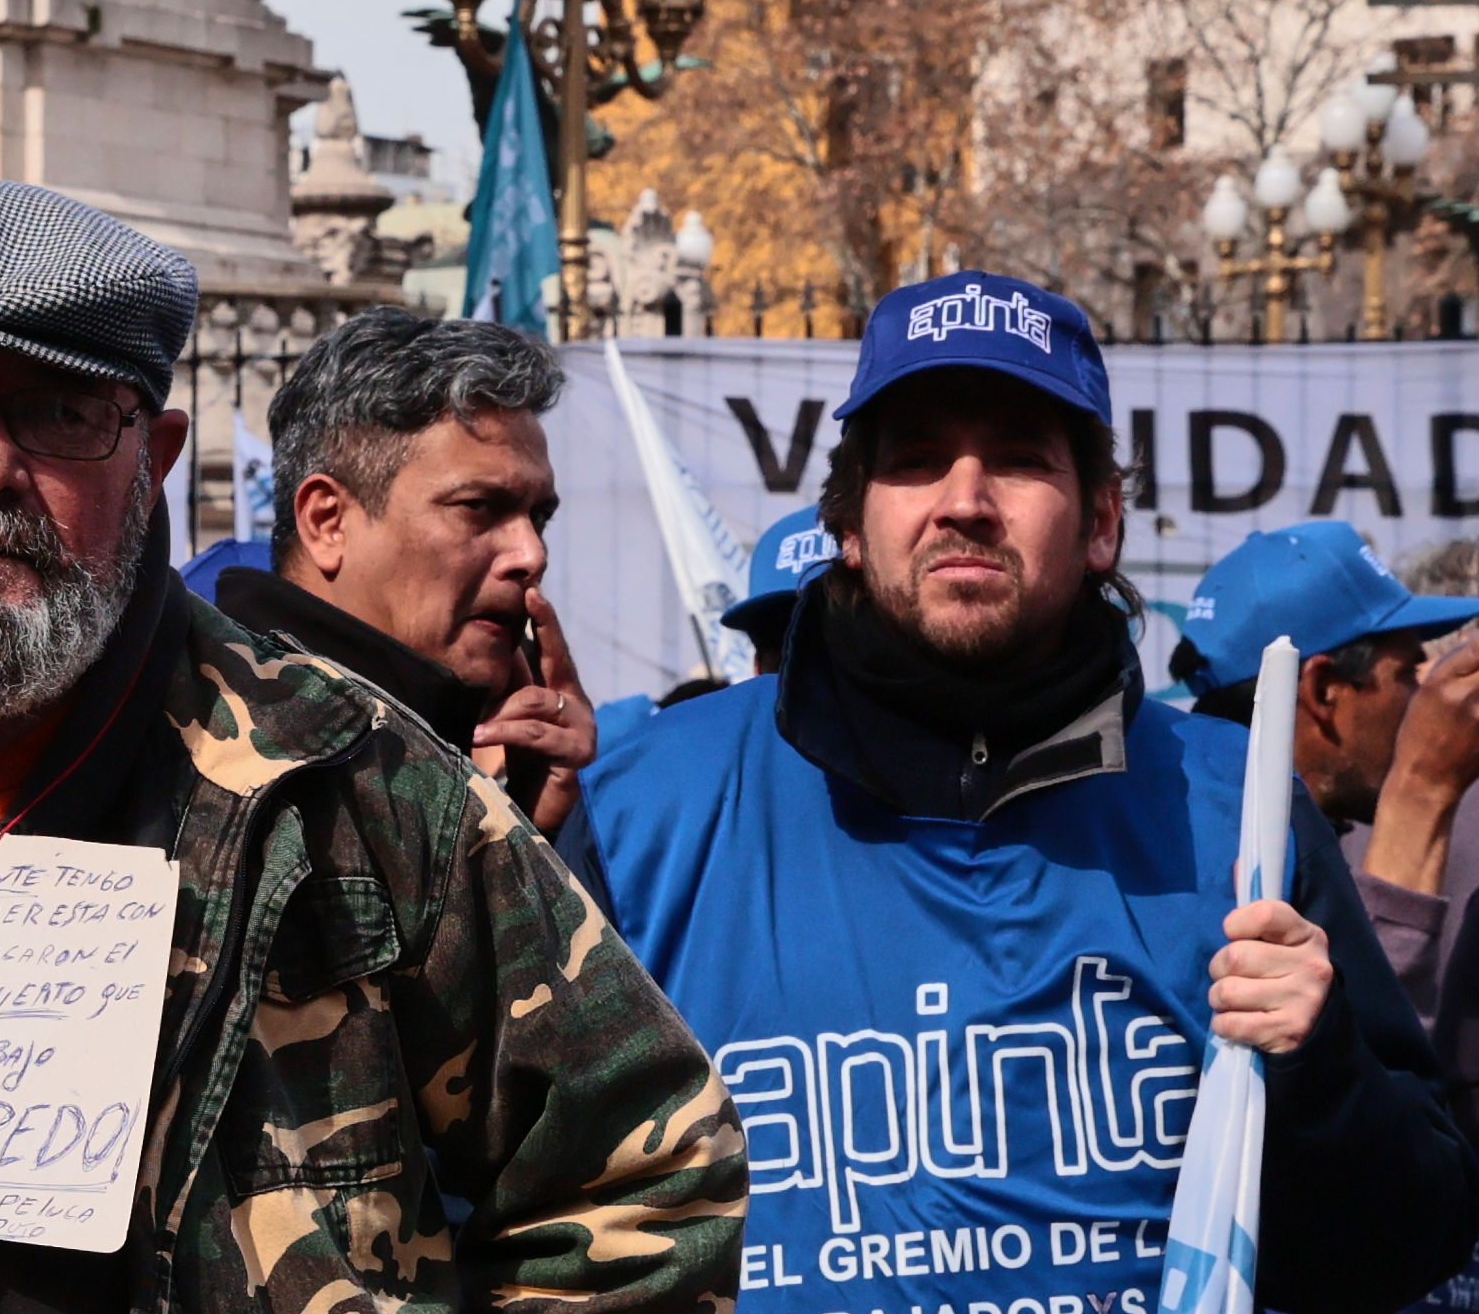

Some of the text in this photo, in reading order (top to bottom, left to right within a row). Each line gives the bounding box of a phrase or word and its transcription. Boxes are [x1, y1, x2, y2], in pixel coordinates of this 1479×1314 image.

[54, 864, 134, 892] TENGO
[48, 900, 109, 927] ESTA
[115, 899, 166, 921] CON
[715, 956, 1200, 1234] apinta
[740, 1244, 803, 1290] EL
[818, 1225, 1033, 1283] GREMIO
[1050, 1221, 1121, 1266] DE
